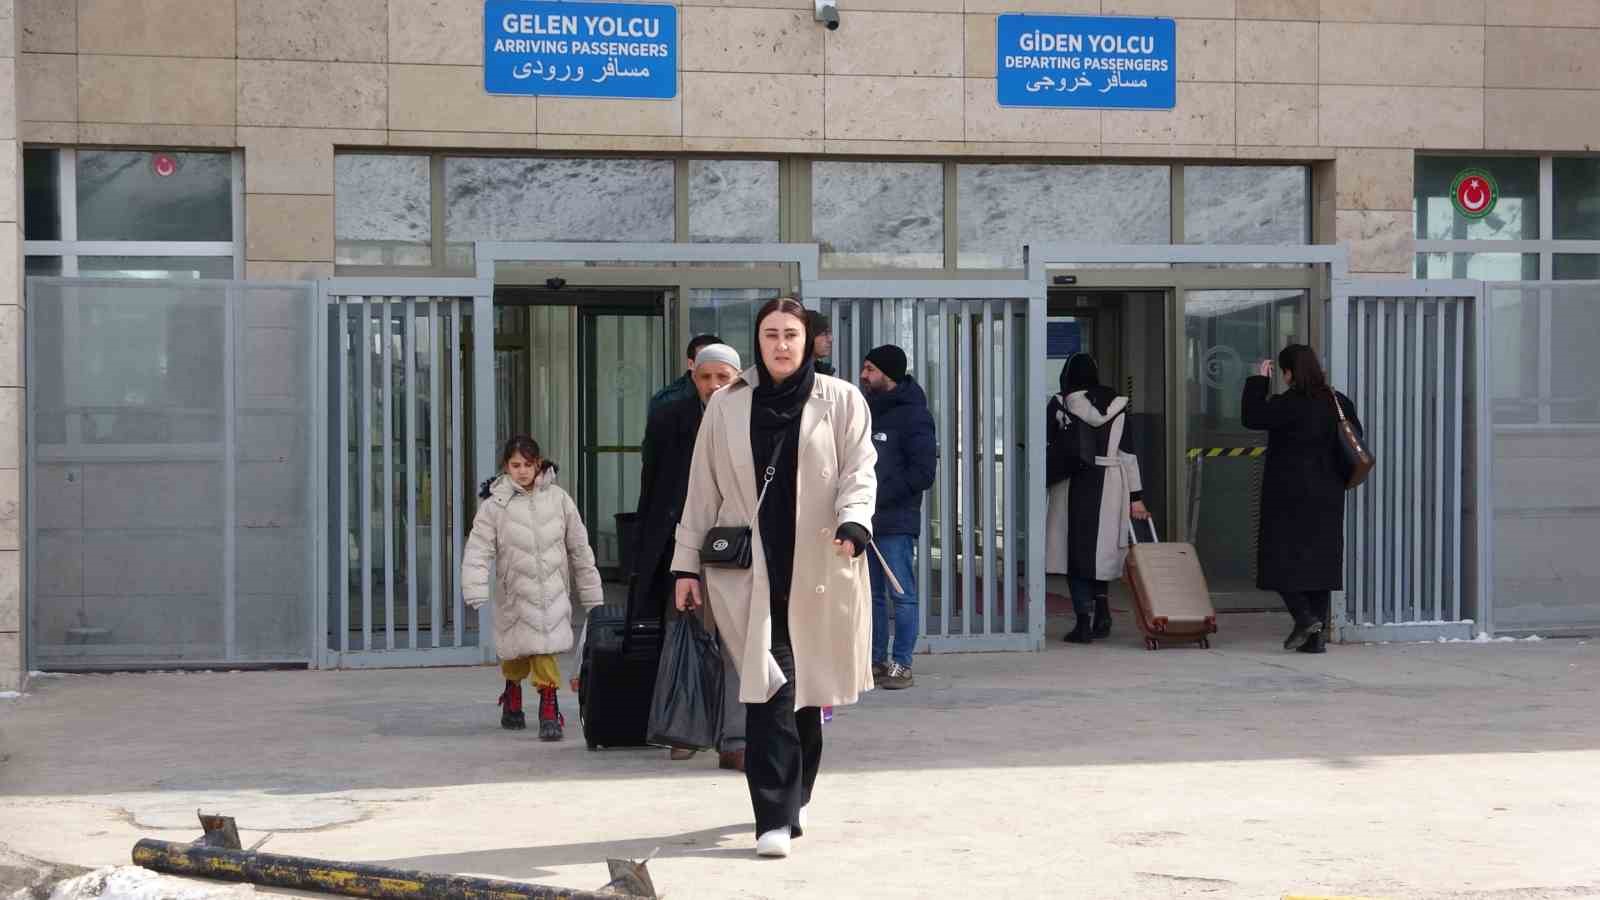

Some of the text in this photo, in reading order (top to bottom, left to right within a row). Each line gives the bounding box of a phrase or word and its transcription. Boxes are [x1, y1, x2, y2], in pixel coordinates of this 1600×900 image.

[502, 13, 660, 38] GELEN YOLCU
[494, 39, 668, 57] ARRIVING PASSENGERS
[1019, 29, 1154, 54] GİDEN YOLCU
[592, 57, 650, 83] مسافر
[1005, 55, 1168, 72] DEPARTING PASSENGERS
[1098, 71, 1147, 93] مسافر
